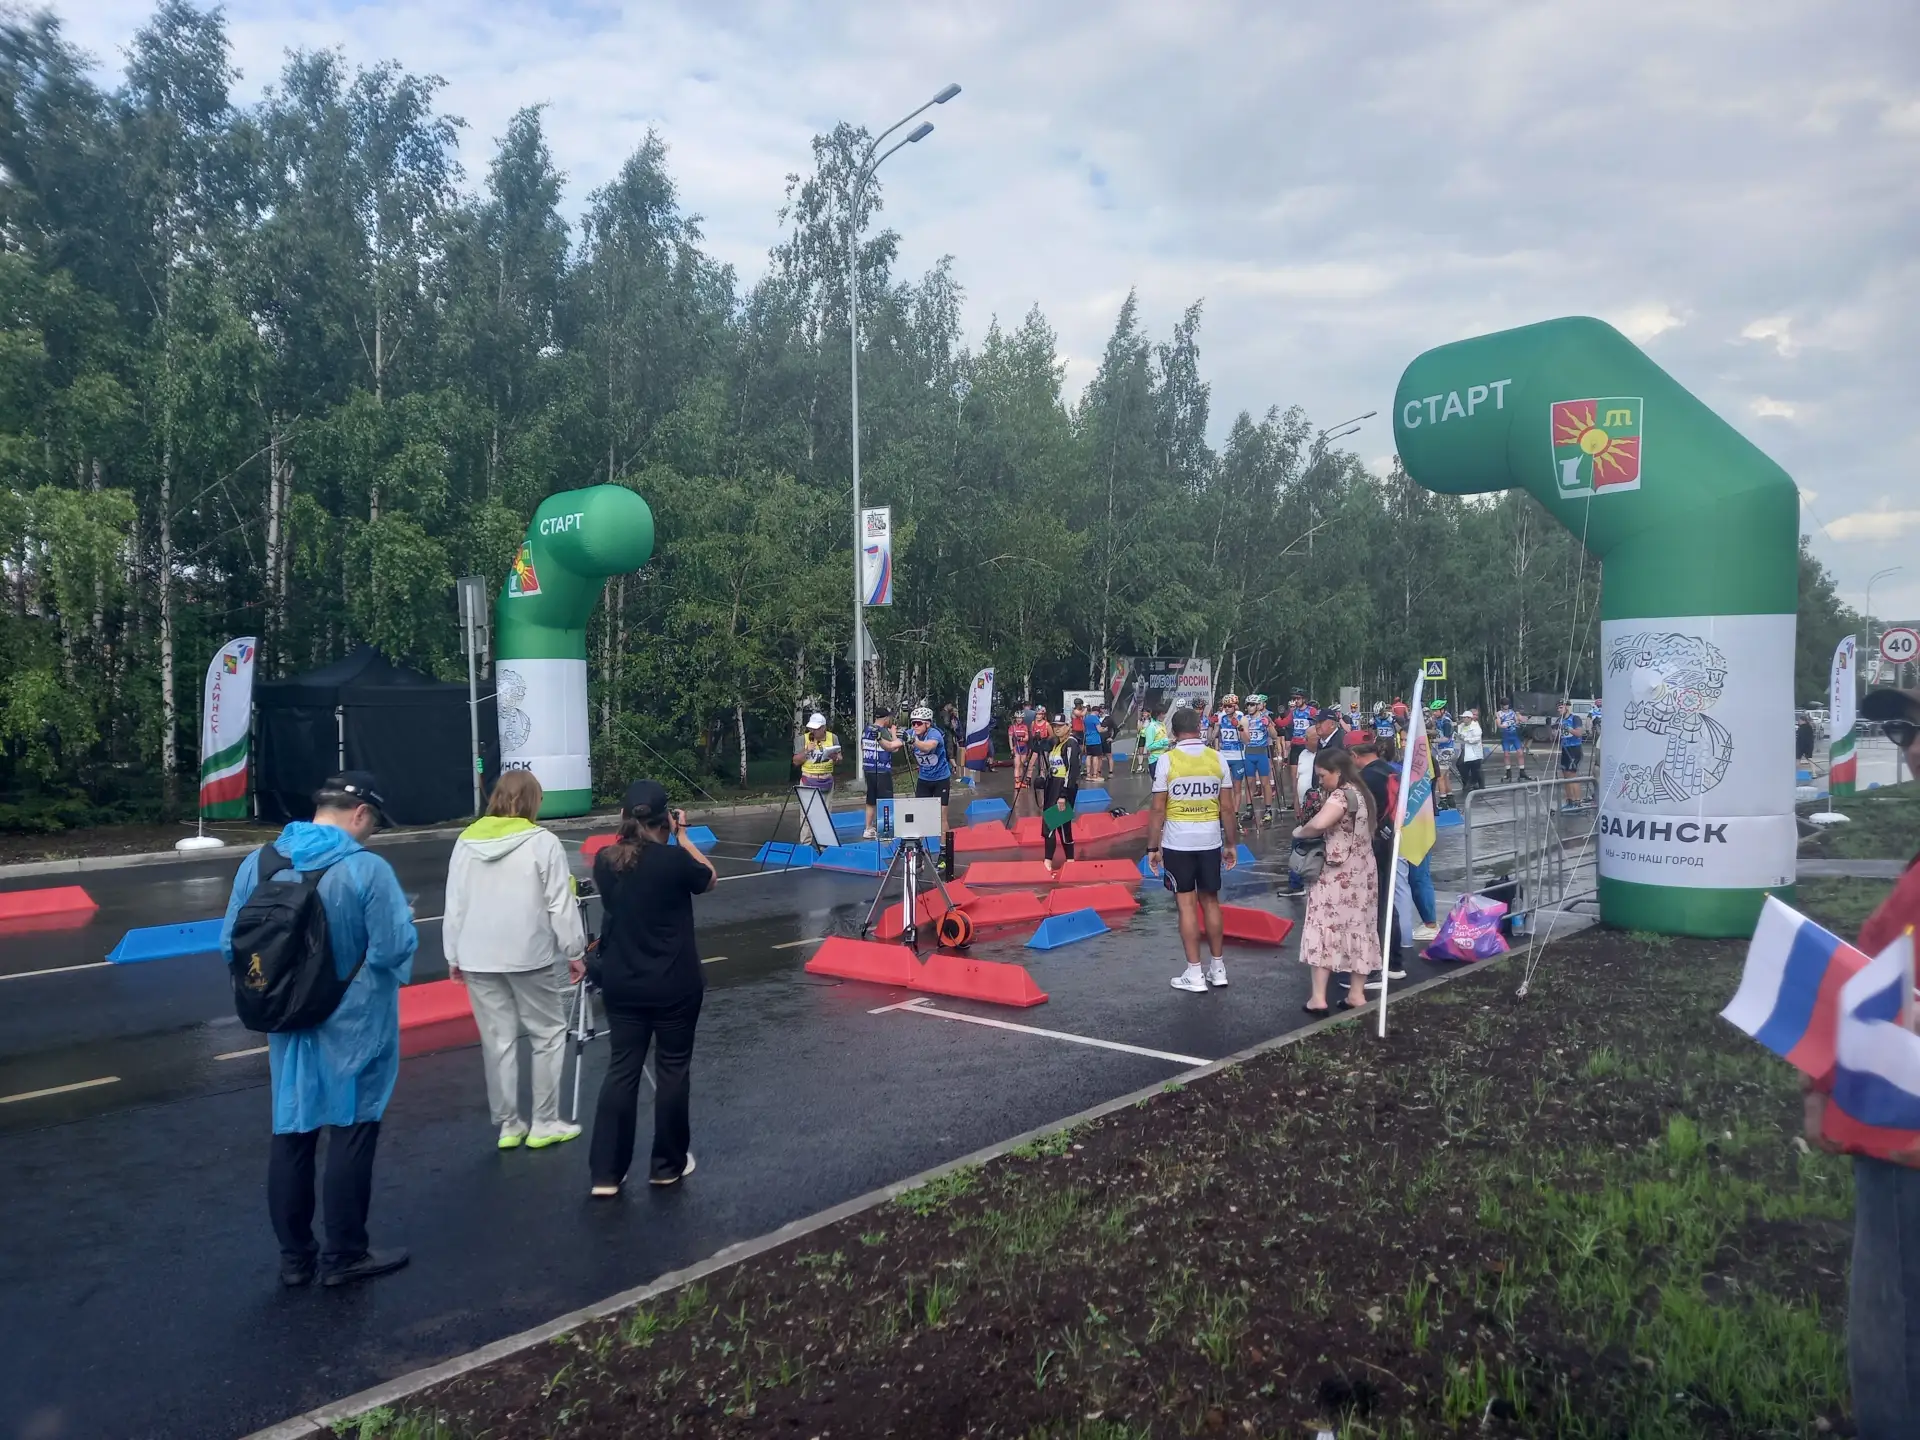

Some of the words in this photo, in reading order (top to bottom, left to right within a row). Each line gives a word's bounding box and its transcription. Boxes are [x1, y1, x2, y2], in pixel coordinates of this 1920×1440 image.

[1403, 378, 1512, 429] СТАРТ
[540, 512, 584, 535] СТАРТ
[1888, 638, 1912, 653] 40
[1178, 675, 1209, 686] РОССИИ
[211, 671, 222, 734] ЗАИНСК
[1294, 720, 1304, 728] 25
[1223, 731, 1235, 740] 22
[1172, 782, 1219, 797] СУДЬЯ
[1600, 814, 1729, 844] ЗАИНСК
[1621, 851, 1637, 862] ЭТО
[1638, 855, 1662, 864] НАШ
[1665, 857, 1704, 868] ГОРОД
